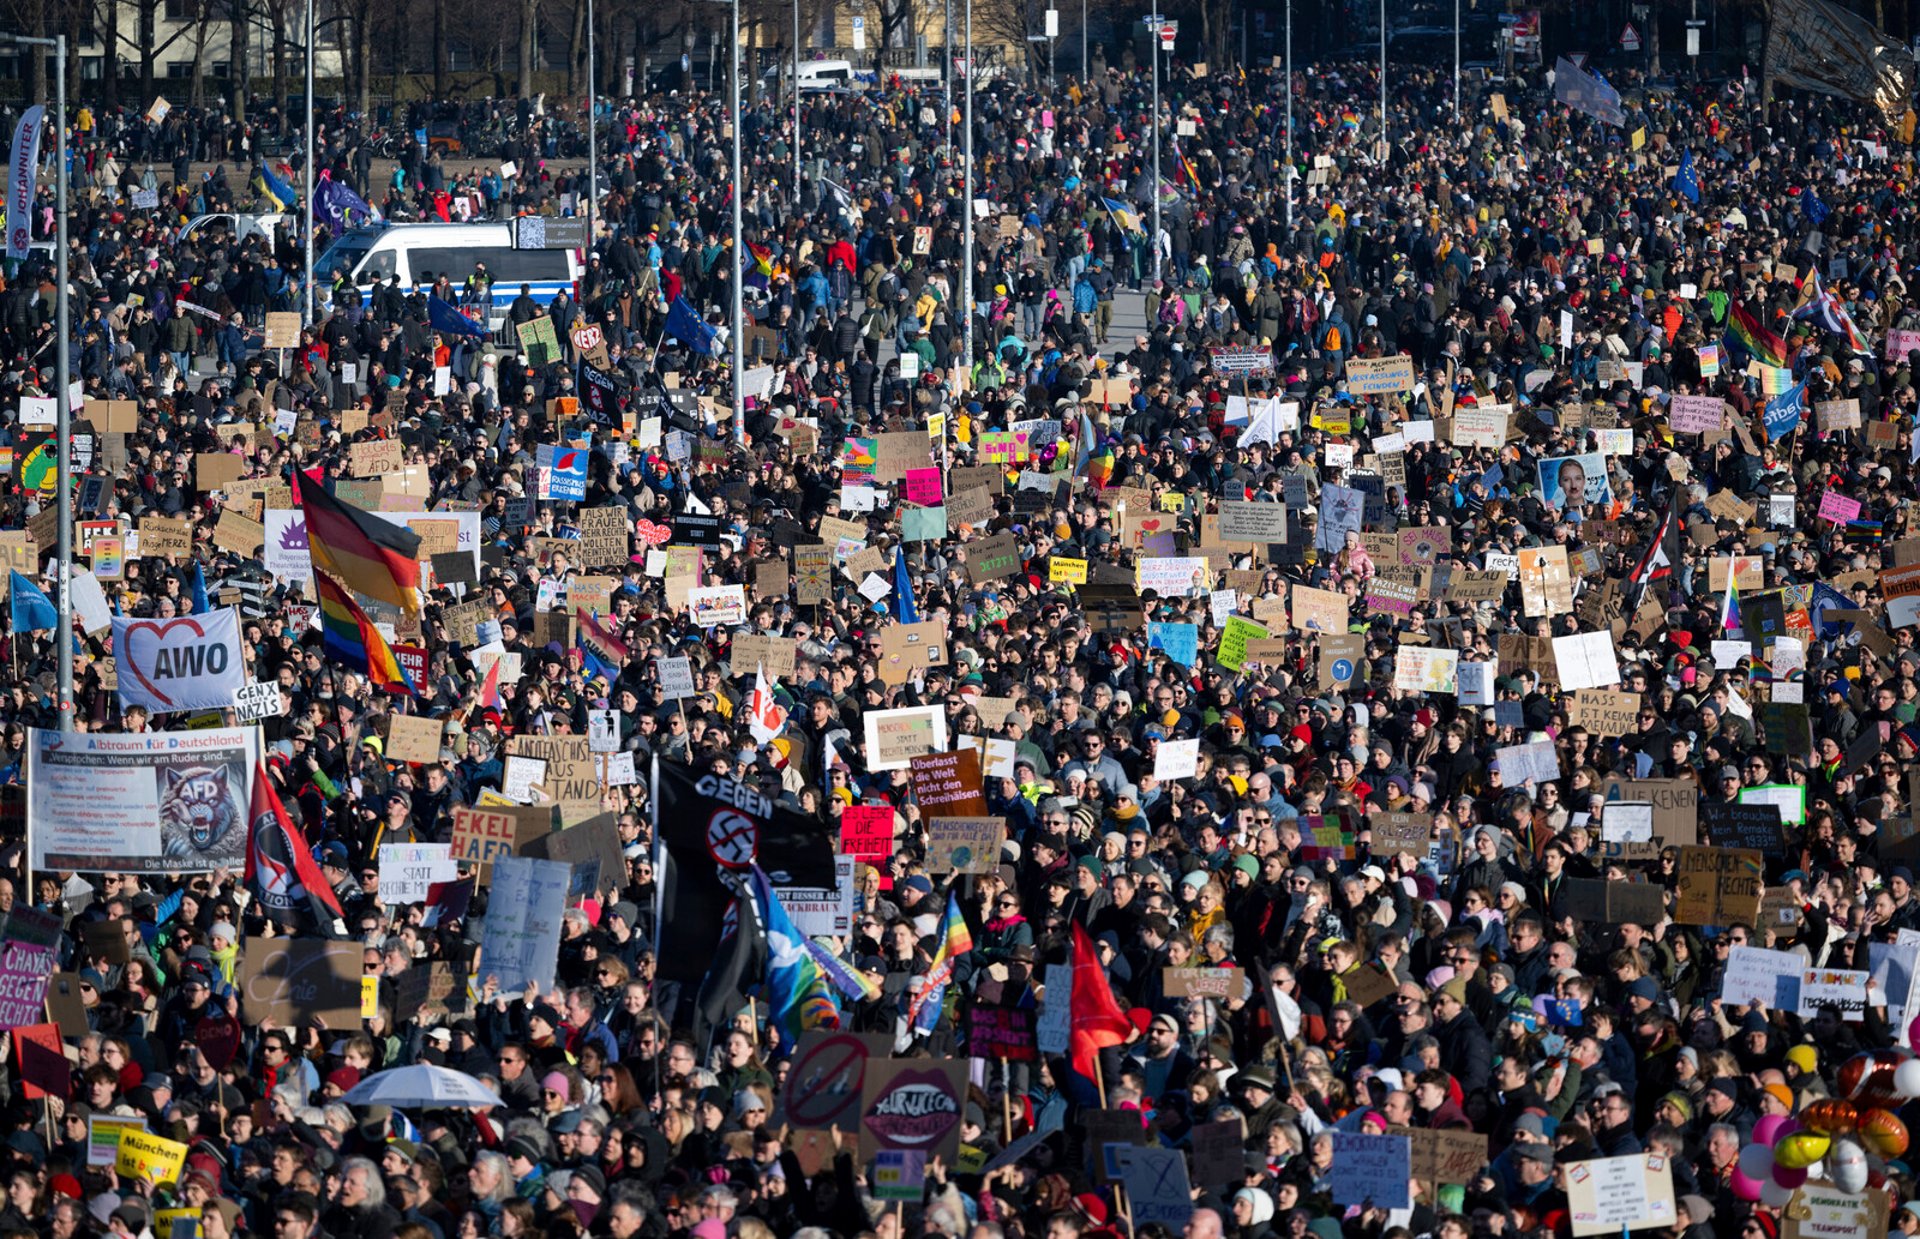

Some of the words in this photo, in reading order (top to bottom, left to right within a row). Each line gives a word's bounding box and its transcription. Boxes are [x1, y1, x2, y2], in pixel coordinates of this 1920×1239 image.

[18, 122, 33, 216] JOHANNITER
[574, 327, 601, 349] HERZ
[584, 366, 614, 391] GEGEN
[1349, 371, 1409, 383] VERFASSUNGS
[369, 460, 390, 473] AFD
[552, 475, 586, 488] RASSISMUS
[586, 508, 604, 518] ALS
[606, 507, 622, 517] WIR
[582, 518, 624, 528] FRAUEN
[582, 528, 602, 538] MEHR
[602, 527, 626, 536] RECHTE
[278, 552, 310, 563] Bayerisch
[612, 547, 626, 556] WIR
[582, 557, 603, 566] NICHT
[980, 555, 1015, 573] JETZT!
[1053, 561, 1085, 570] München
[1464, 570, 1500, 582] BLAU
[573, 583, 601, 593] HASS
[1371, 577, 1397, 590] FAZIT
[572, 593, 601, 602] MACHT
[1512, 637, 1547, 659] AFD
[154, 642, 229, 681] AWO
[237, 685, 265, 701] GEN
[266, 682, 278, 696] X
[1581, 694, 1615, 706] HASS
[235, 700, 280, 723] NAZIS
[1580, 708, 1599, 718] IST
[1604, 710, 1635, 723] KEINE
[88, 738, 143, 752] Albtraum
[146, 736, 165, 751] für
[168, 733, 244, 750] Deutschland
[107, 755, 135, 767] Wenn
[136, 755, 152, 766] wir
[153, 756, 170, 766] am
[171, 752, 201, 765] Ruder
[911, 754, 959, 772] Überlasst
[915, 770, 931, 782] die
[932, 769, 956, 781] Welt
[180, 783, 217, 802] AFD
[917, 782, 942, 796] nicht
[943, 779, 962, 791] den
[695, 775, 773, 820] GEGEN
[918, 790, 983, 807] Schreihälsen.
[1651, 788, 1697, 811] KENEN
[844, 808, 857, 820] ES
[860, 808, 890, 820] LEBE
[1731, 808, 1777, 821] brauchen
[455, 811, 514, 839] EKEL
[855, 820, 875, 835] DIE
[930, 819, 1001, 833] MENSCHENRECHTE
[1737, 823, 1773, 835] Remake
[452, 835, 513, 862] HAFD
[843, 839, 891, 855] FREIHEIT
[145, 858, 161, 870] Die
[162, 858, 194, 870] Maske
[194, 857, 207, 868] ist
[403, 866, 433, 880] STATT
[379, 881, 411, 897] RECHTE
[259, 890, 294, 908] TION
[776, 891, 791, 901] IST
[791, 891, 825, 902] BESSER
[825, 891, 842, 901] ALS
[783, 902, 840, 914] ACKBRAUN
[0, 973, 46, 1004] GEGEN
[123, 1136, 180, 1161] München
[122, 1152, 136, 1170] ist
[1810, 1196, 1859, 1209] DEMOKRATIE
[1811, 1223, 1858, 1235] TEAMSPORT
